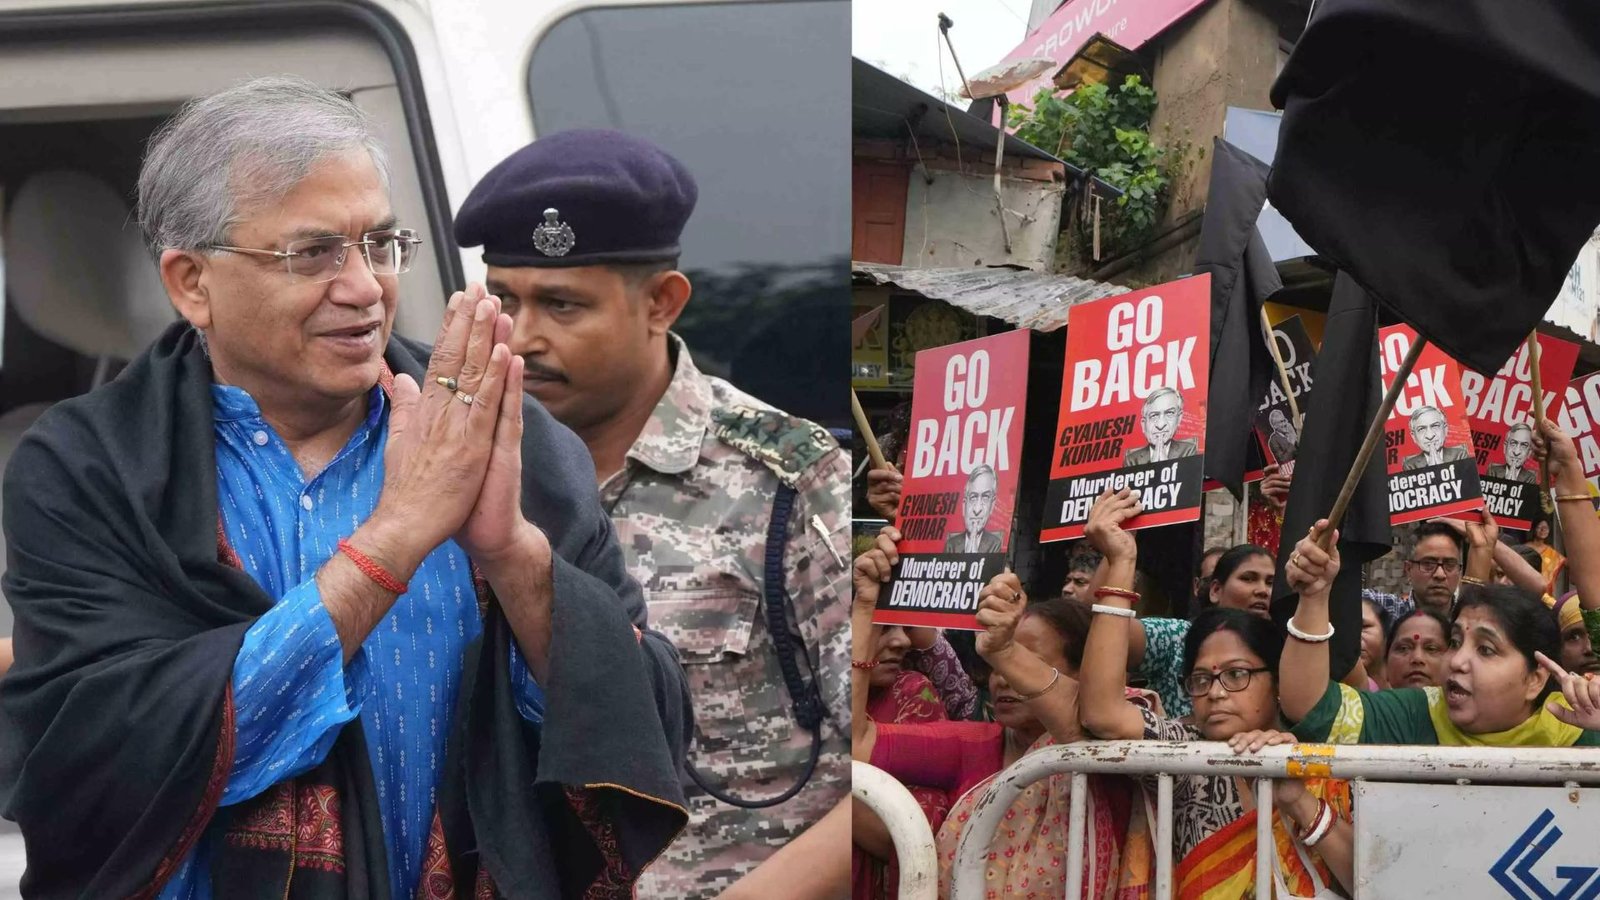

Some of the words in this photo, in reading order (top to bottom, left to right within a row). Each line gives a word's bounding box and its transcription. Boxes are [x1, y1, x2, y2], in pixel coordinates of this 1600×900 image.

[1107, 295, 1163, 352] GO
[1261, 318, 1297, 370] O
[944, 349, 990, 412] GO
[1070, 336, 1197, 413] BACK
[911, 406, 1015, 479] BACK
[1059, 414, 1137, 447] GYANESH
[1059, 438, 1124, 468] KUMAR
[1070, 469, 1155, 498] Murderer
[1160, 462, 1179, 484] of
[1387, 471, 1435, 492] derer
[1440, 464, 1455, 481] of
[1510, 484, 1524, 499] of
[900, 491, 960, 517] GYANESH
[1389, 480, 1462, 513] OCRACY
[900, 517, 947, 541] KUMAR
[900, 557, 966, 580] Murderer
[969, 557, 985, 580] of
[889, 580, 985, 610] DEMOCRACY
